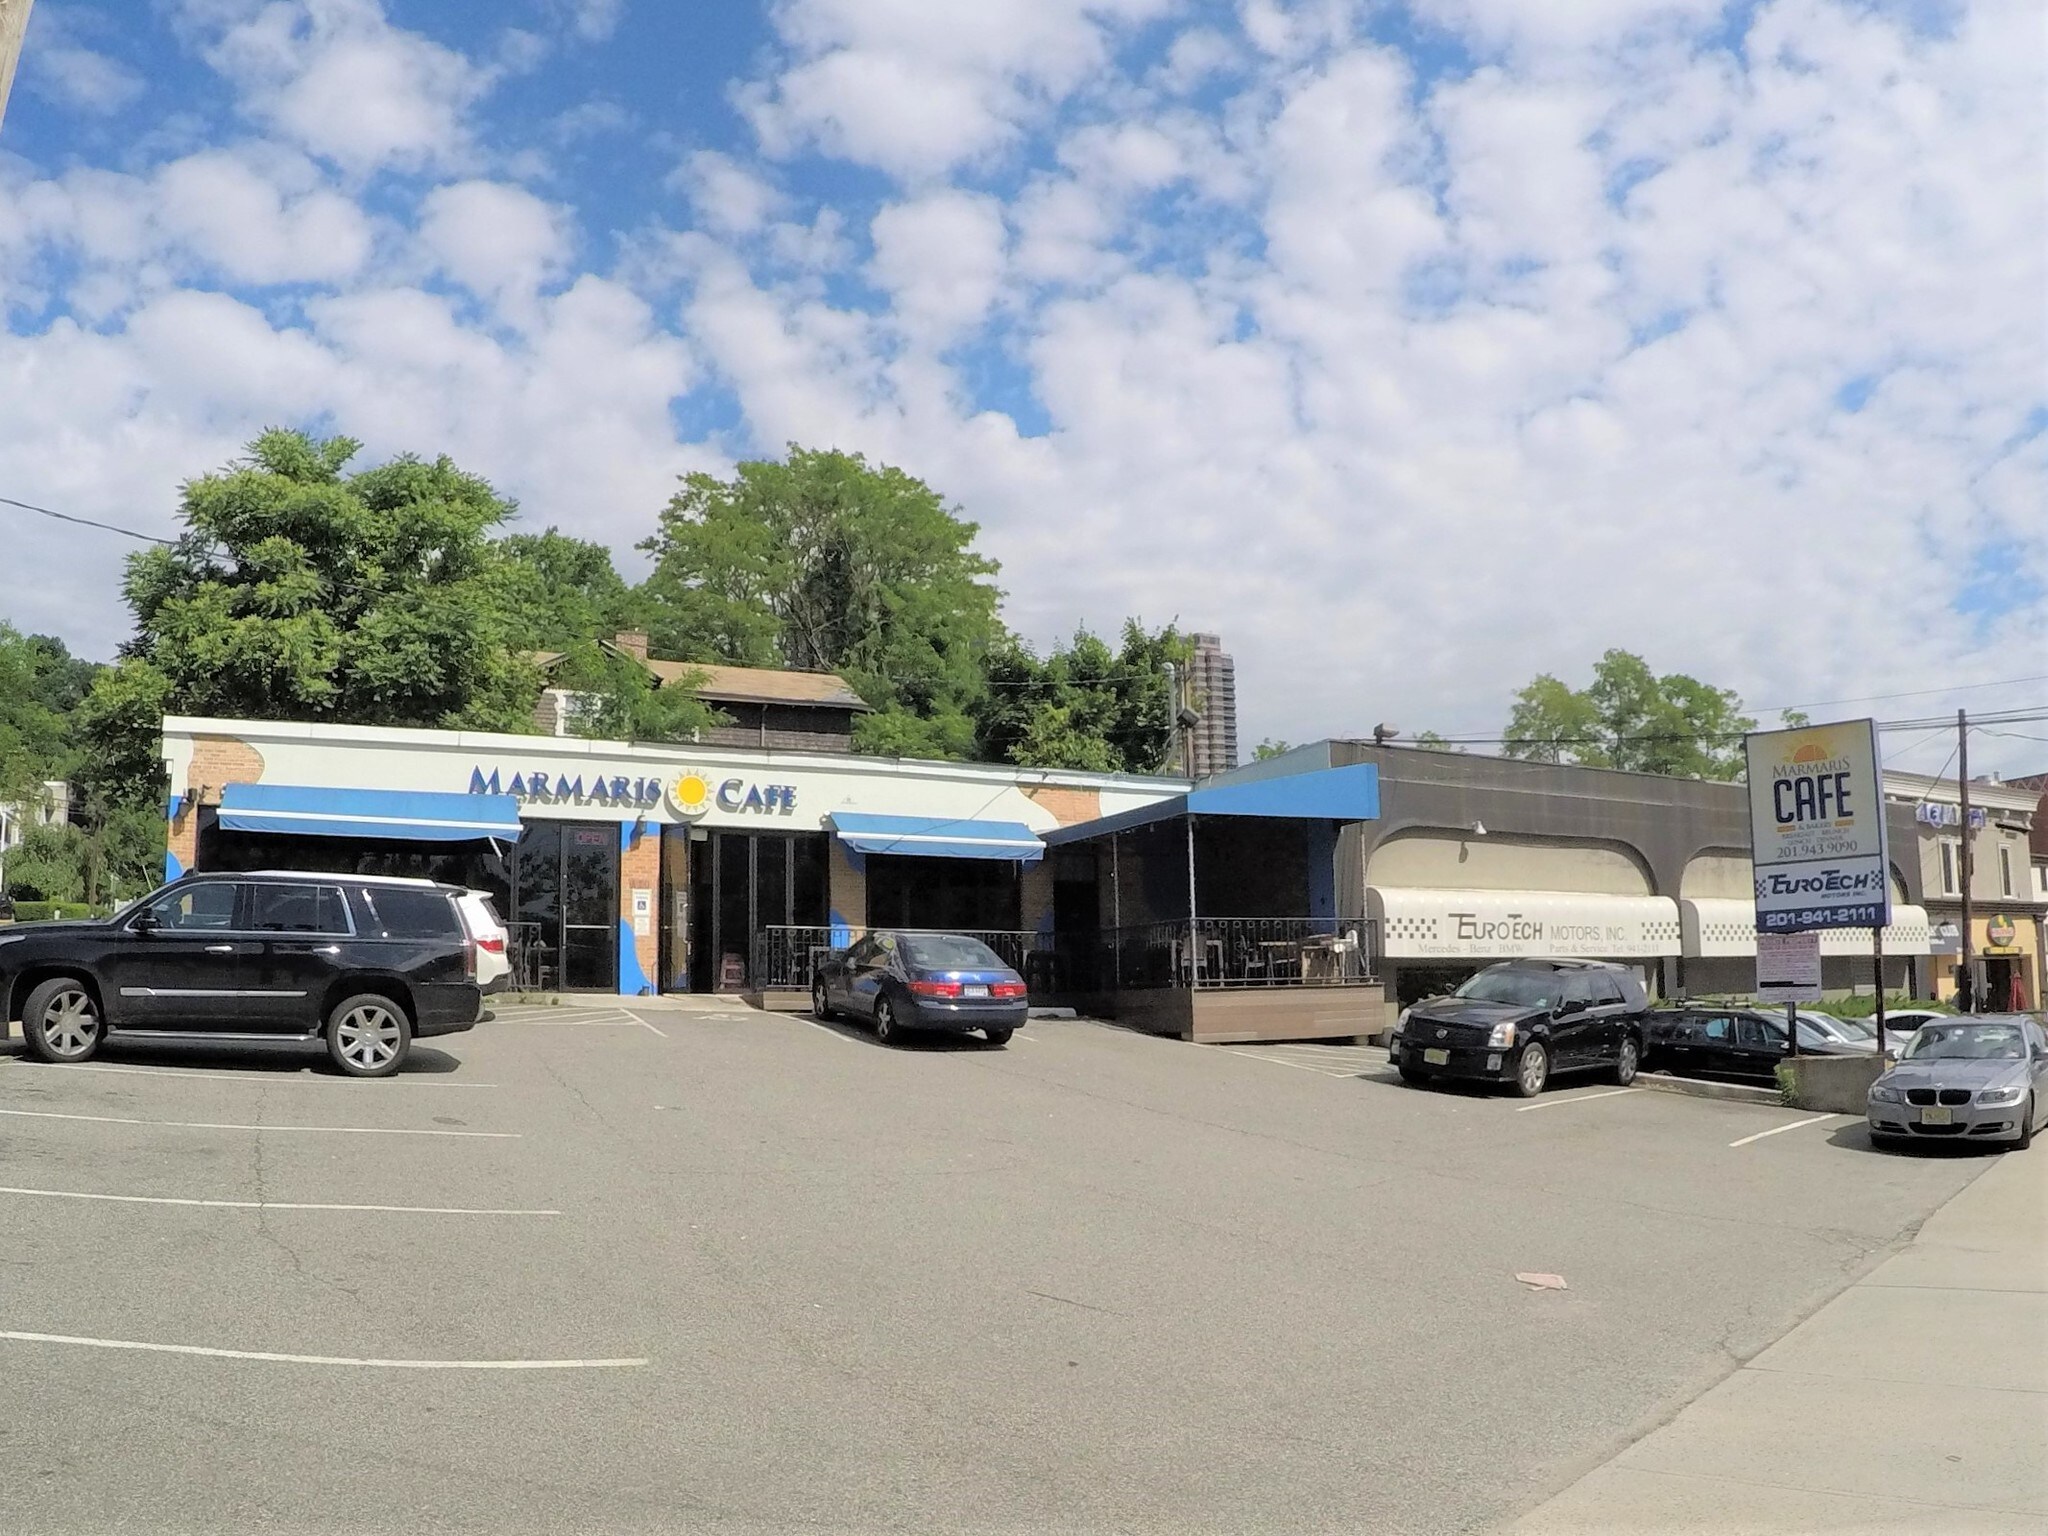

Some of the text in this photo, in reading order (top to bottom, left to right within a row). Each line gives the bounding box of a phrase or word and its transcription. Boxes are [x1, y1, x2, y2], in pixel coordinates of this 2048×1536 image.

[1773, 757, 1850, 778] MARMARIS
[469, 764, 798, 812] MARMARIS CAFE
[1773, 772, 1854, 824] CAFE
[576, 831, 607, 845] OPEN
[1776, 840, 1858, 859] 201.943.9090
[1820, 891, 1851, 899] MOTORS
[1765, 906, 1877, 927] 201-941-2111
[1550, 925, 1603, 943] MOTORS,
[1605, 925, 1628, 942] INC.
[1498, 943, 1525, 954] BMW
